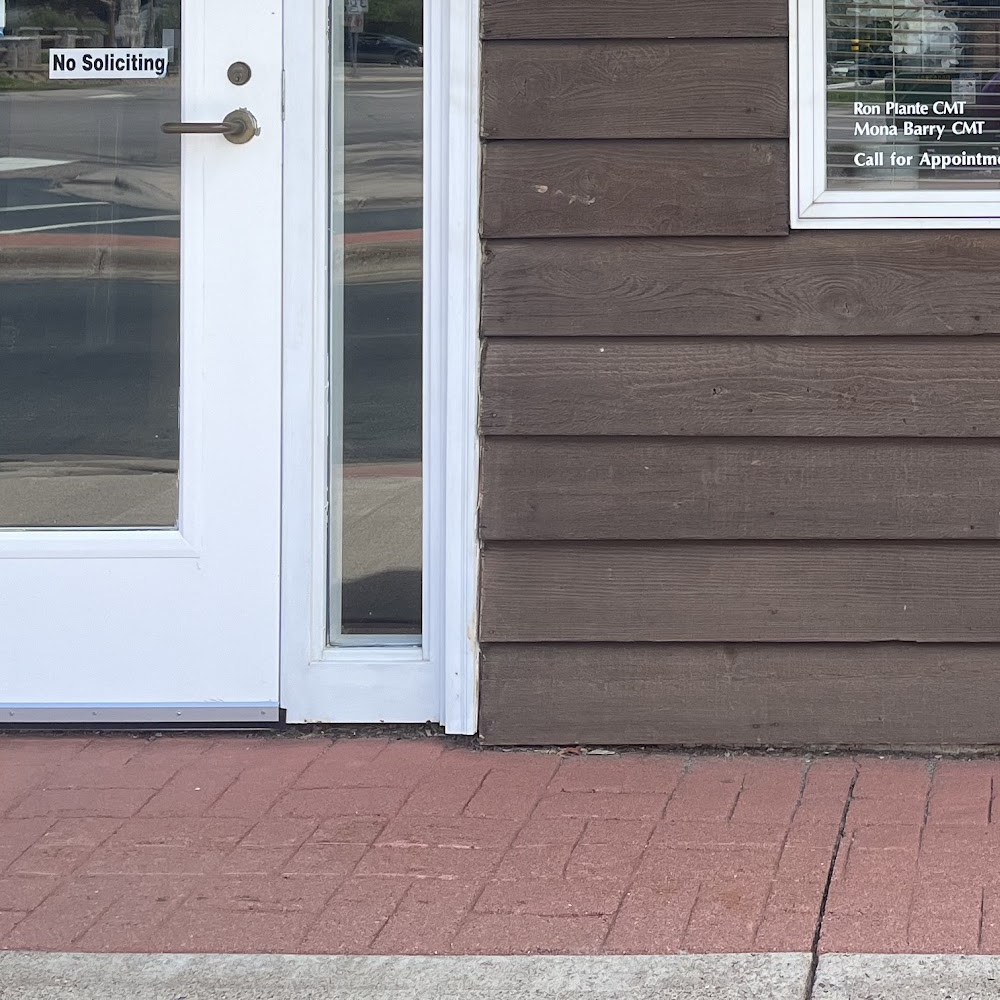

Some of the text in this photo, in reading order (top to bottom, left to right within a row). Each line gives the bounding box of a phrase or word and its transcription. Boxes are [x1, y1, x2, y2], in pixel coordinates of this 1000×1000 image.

[53, 53, 165, 75] No Soliciting
[854, 101, 880, 115] Ron
[885, 101, 929, 115] Plante
[933, 101, 966, 115] CMT
[854, 121, 898, 136] Mona
[903, 121, 945, 140] Barry
[952, 121, 985, 135] CMT
[854, 152, 884, 167] Call
[890, 152, 913, 167] for
